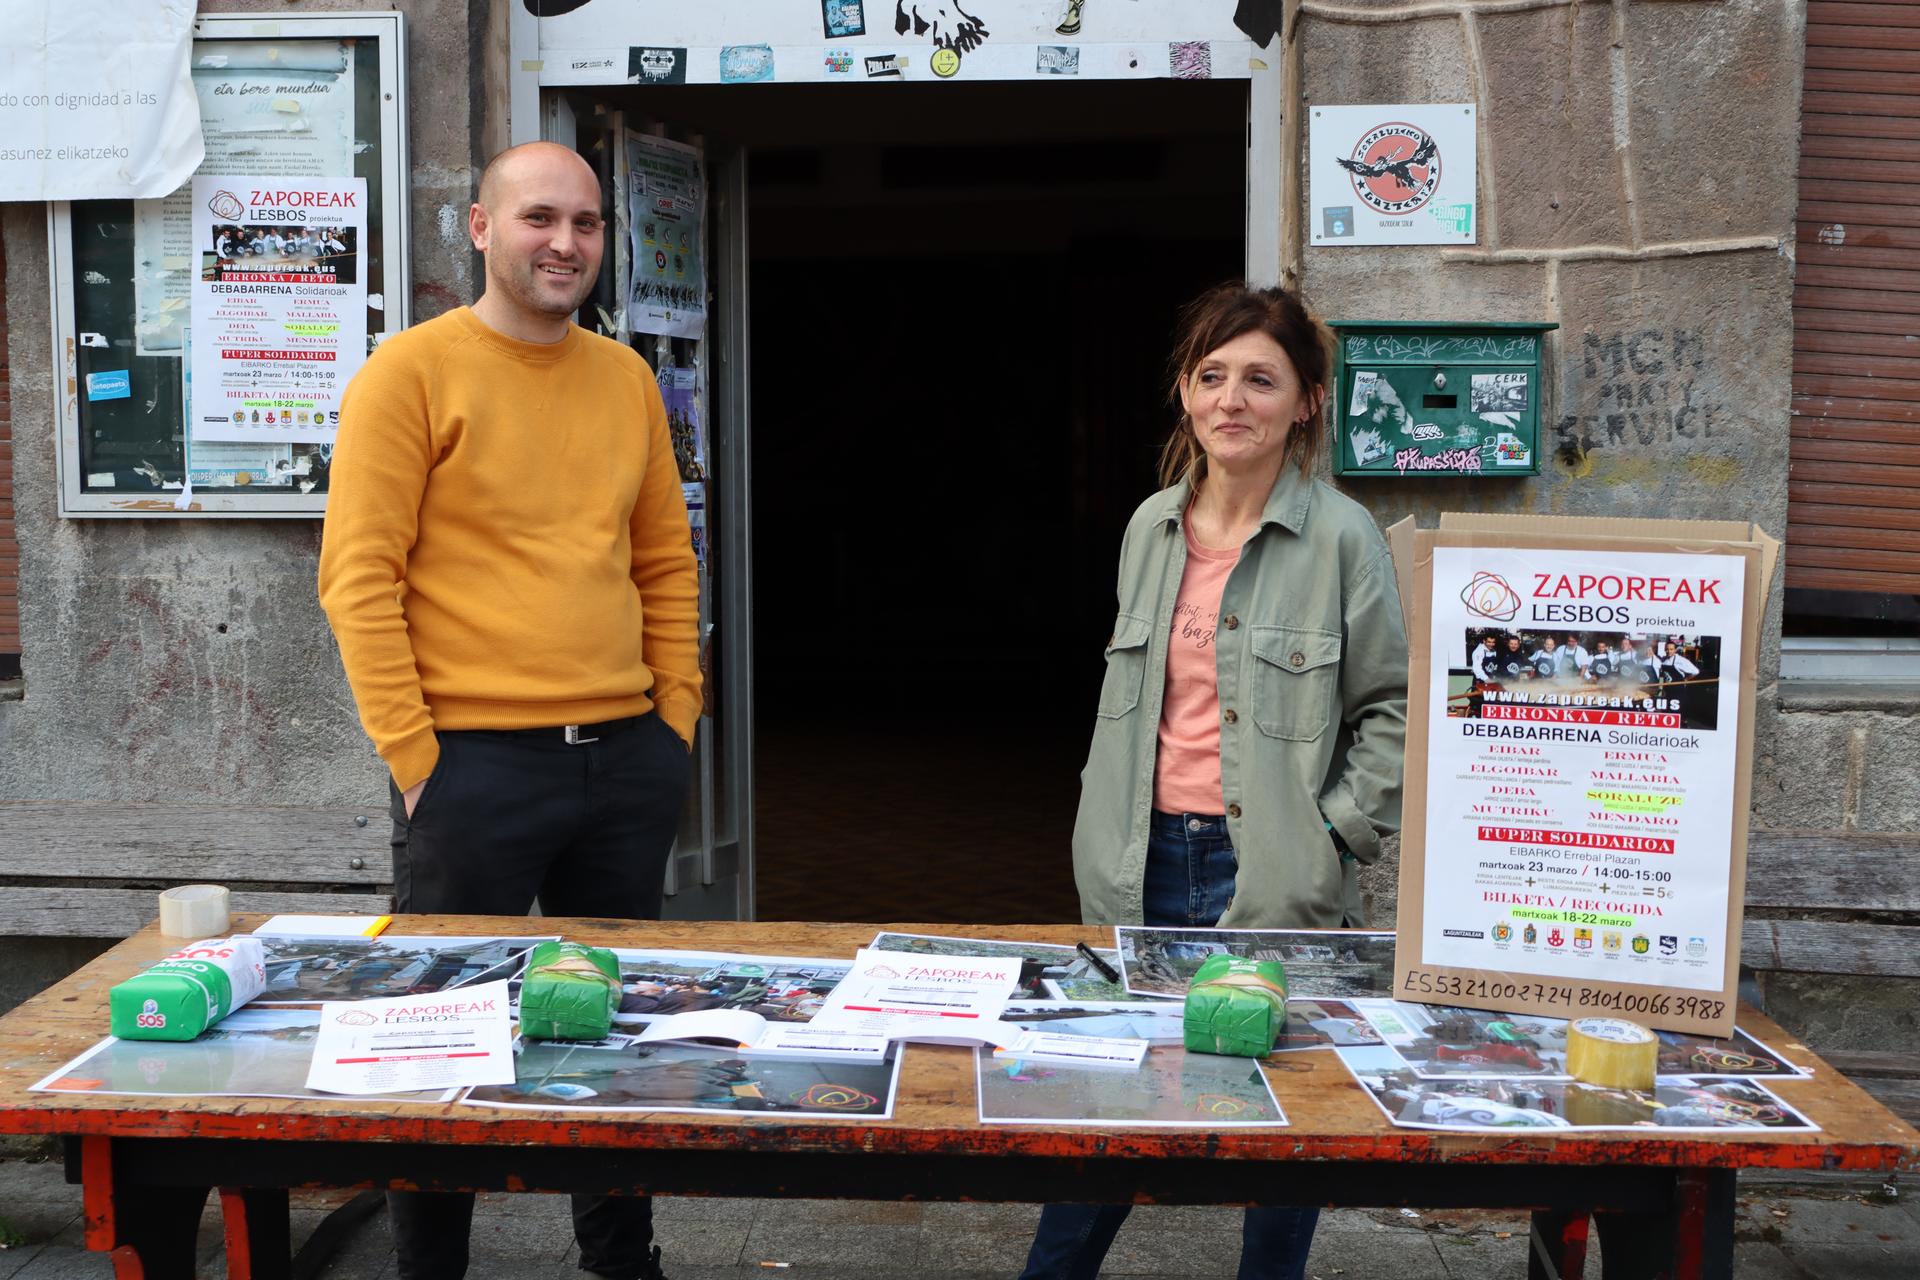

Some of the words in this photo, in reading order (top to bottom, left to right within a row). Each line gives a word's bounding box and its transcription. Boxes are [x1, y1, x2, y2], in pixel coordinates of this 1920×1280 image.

[214, 82, 235, 96] eta
[240, 82, 270, 96] bere
[276, 81, 331, 94] mundua
[23, 95, 49, 106] con
[54, 92, 118, 110] dignidad
[123, 94, 132, 105] a
[136, 92, 157, 105] las
[0, 148, 52, 160] asunez
[57, 144, 129, 160] elikatzeko
[250, 190, 356, 208] ZAPOREAK
[250, 209, 306, 222] LESBOS
[222, 264, 336, 274] www.zaporeak.eus
[224, 273, 285, 282] ERRONKA
[300, 274, 334, 283] RETO
[211, 284, 292, 295] DEBABARRENA
[296, 286, 348, 296] Solidarioak
[224, 350, 262, 360] TUPER
[264, 351, 335, 360] SOLIDARIOA
[227, 391, 269, 399] BILKETA
[279, 392, 331, 400] RECOGIDA
[1502, 452, 1524, 460] BOSS
[1532, 574, 1721, 604] ZAPOREAK
[1532, 604, 1630, 624] LESBOS
[1636, 616, 1695, 627] proiektua
[1483, 690, 1680, 712] www.zaporeak.eus
[1486, 706, 1590, 723] ERRONKA
[1600, 712, 1607, 723] /
[1618, 713, 1676, 727] RETO
[1462, 723, 1602, 743] DEBABARRENA
[1608, 730, 1700, 749] Solidarioak
[1490, 745, 1540, 756] EIBAR
[1604, 751, 1668, 763] ERMUA
[1471, 764, 1558, 776] ELGOIBAR
[1590, 771, 1680, 784] MALLABIA
[1492, 786, 1536, 796] DEBA
[1587, 792, 1681, 805] SORALUZE
[1472, 805, 1555, 816] MUTRIKU
[1588, 812, 1678, 825] MENDARO
[1480, 827, 1544, 843] TUPER
[1550, 833, 1672, 853] SOLIDARIOA
[1510, 847, 1561, 858] EIBARKO
[1564, 851, 1602, 862] Errebal
[1605, 854, 1641, 865] Plazan
[1479, 860, 1525, 871] martxoak
[1528, 862, 1544, 872] 23
[1547, 866, 1578, 875] marzo
[1582, 865, 1588, 876] /
[1594, 868, 1671, 882] 14:00-15:00
[1484, 891, 1555, 907] BILKETA
[1560, 896, 1568, 908] /
[1572, 898, 1664, 916] RECOGIDA
[1512, 910, 1558, 921] martxoak
[1563, 911, 1597, 924] 18-22
[1600, 916, 1632, 927] marzo
[907, 967, 1007, 981] ZAPOREAK
[385, 1000, 496, 1017] ZAPOREAK
[138, 1015, 164, 1027] SOS
[385, 1014, 460, 1024] LESBOS
